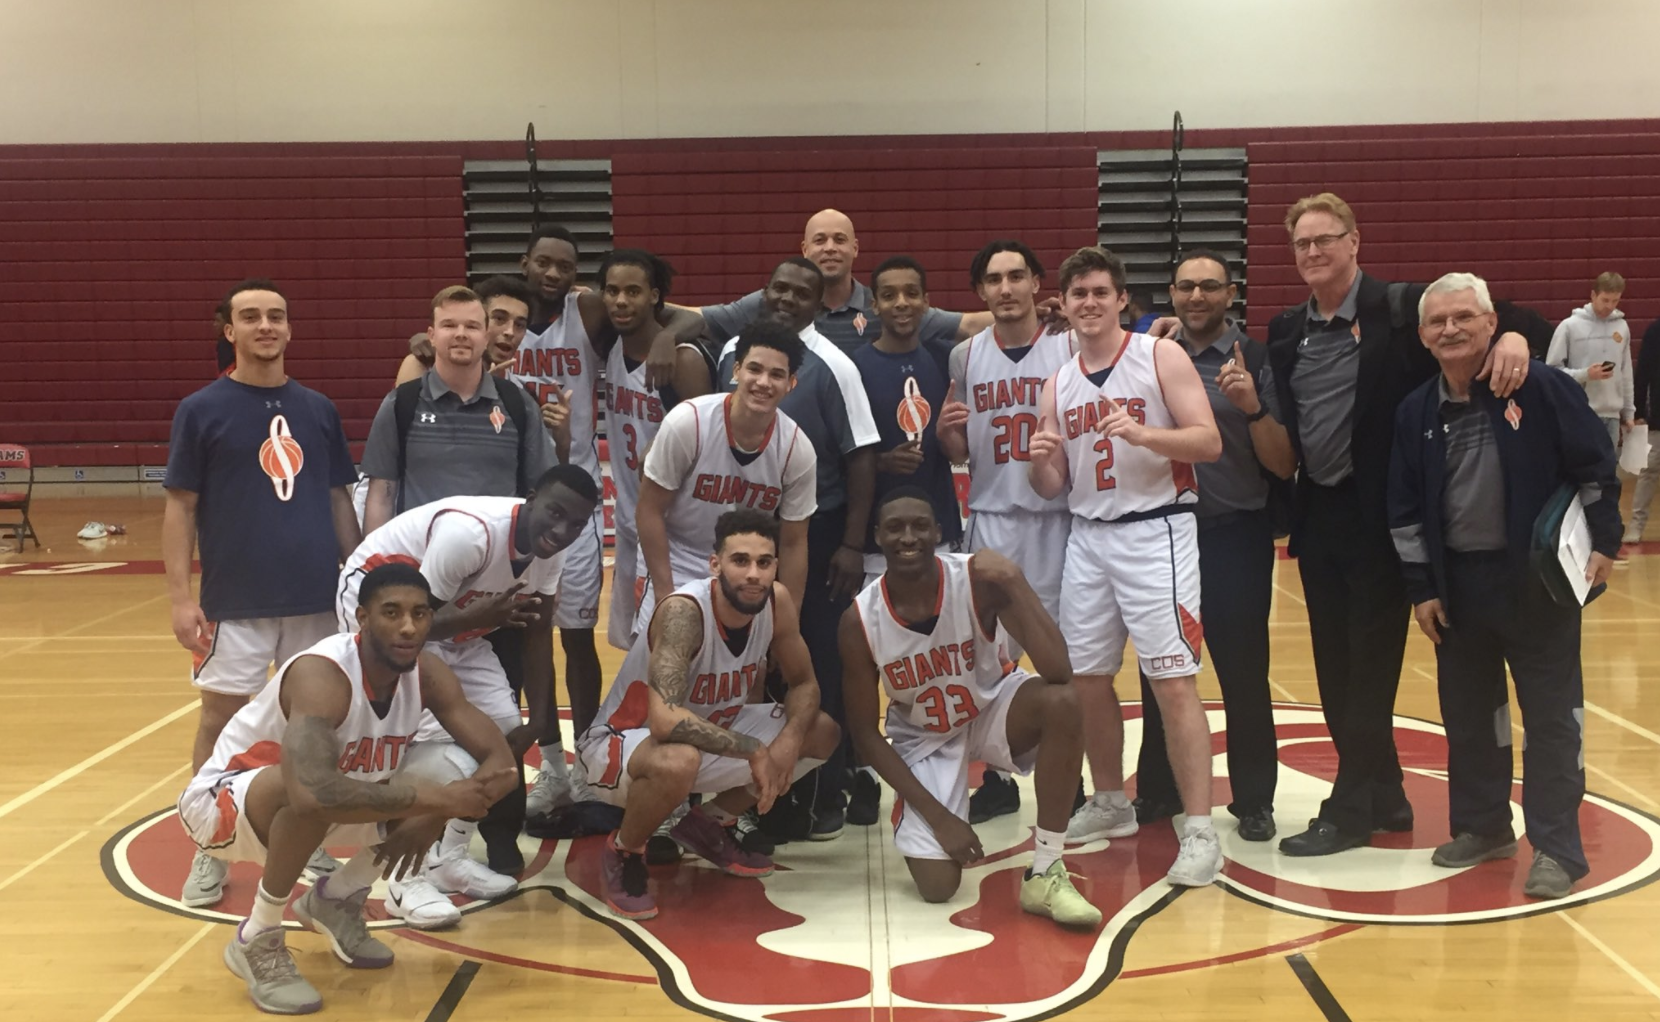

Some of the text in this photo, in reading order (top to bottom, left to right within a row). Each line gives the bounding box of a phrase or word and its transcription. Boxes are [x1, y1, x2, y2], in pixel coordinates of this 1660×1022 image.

[513, 348, 581, 377] IANTS
[623, 424, 638, 471] 3
[991, 413, 1037, 464] 20
[1093, 437, 1116, 491] 2
[692, 473, 781, 511] GIANTS
[689, 663, 757, 705] GIANT
[883, 639, 975, 690] GIANTS
[1151, 654, 1184, 670] COS
[916, 684, 979, 733] 33
